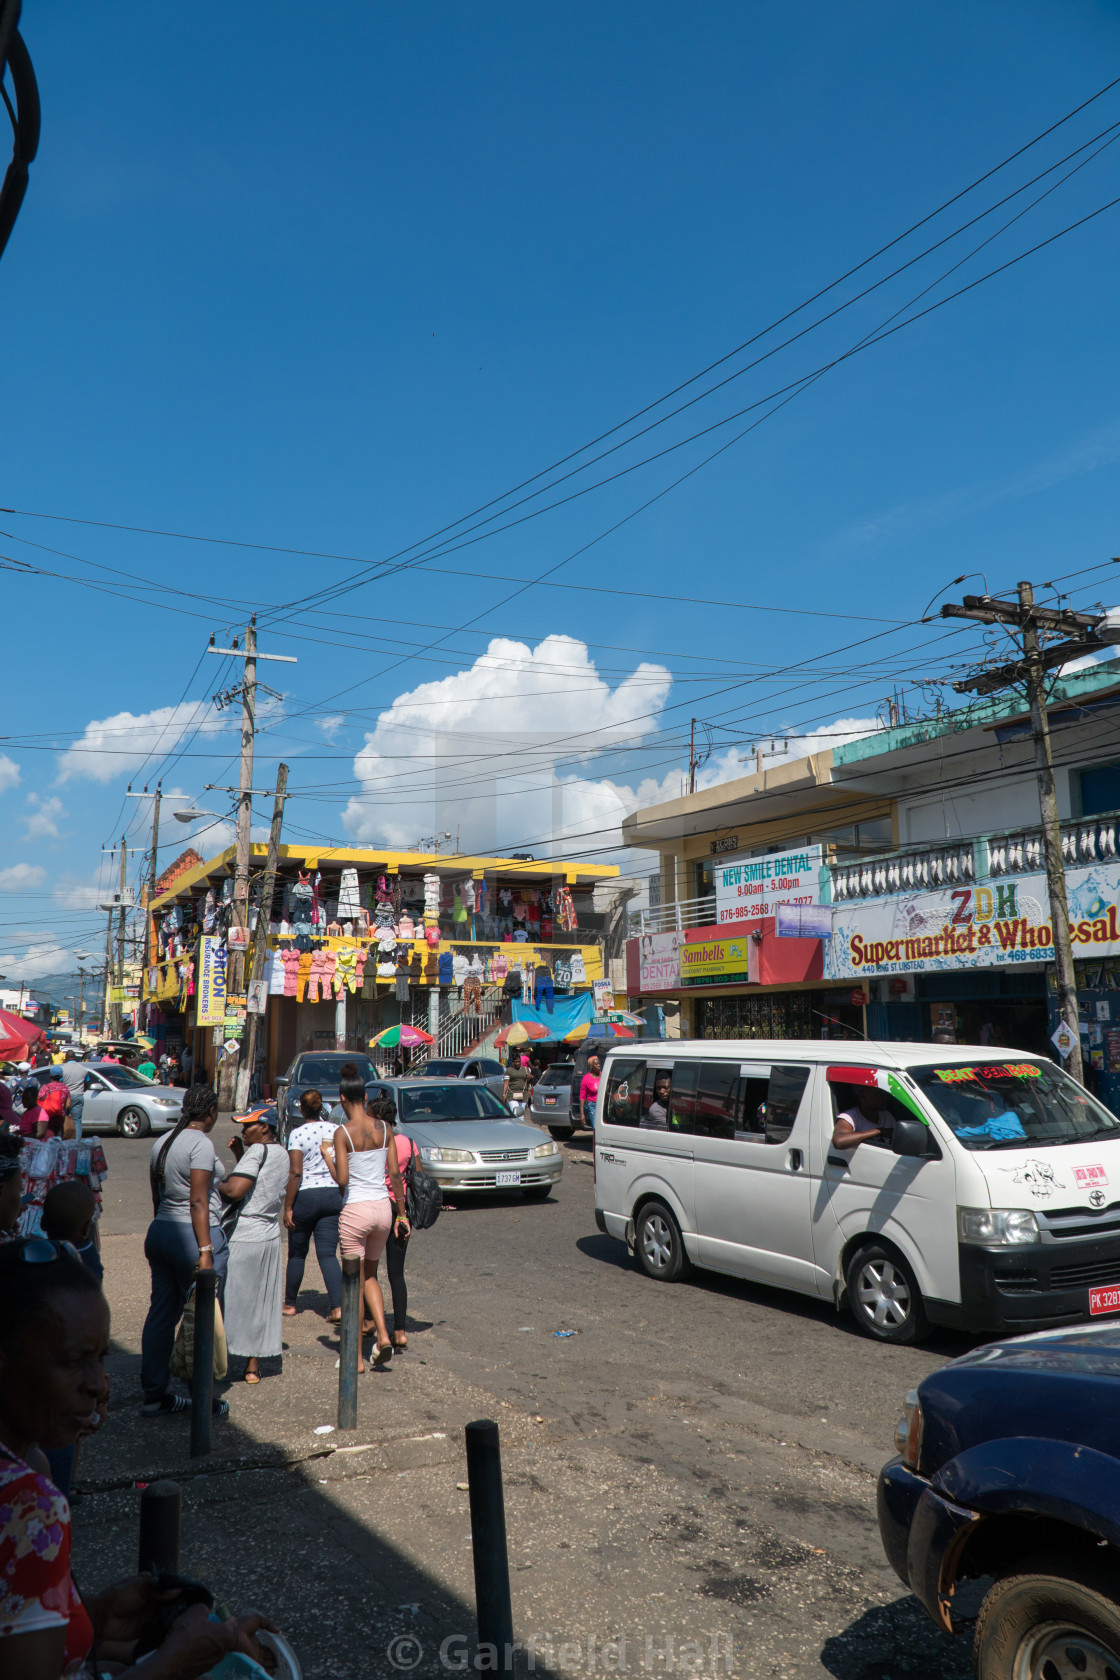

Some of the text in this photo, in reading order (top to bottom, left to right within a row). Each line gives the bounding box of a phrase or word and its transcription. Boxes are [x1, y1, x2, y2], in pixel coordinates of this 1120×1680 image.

[723, 853, 812, 887] NEW SMILE DENTAL
[737, 884, 764, 896] 9.00am
[771, 877, 800, 891] 5.00pm
[720, 903, 769, 921] 876-985-2568
[951, 884, 1017, 924] ZDH
[683, 945, 724, 964] Sambells
[1007, 948, 1055, 961] 468-6833
[202, 937, 211, 1013] INSURANCE BROKERS
[213, 948, 227, 997] ORION
[557, 970, 570, 981] 70
[933, 1067, 977, 1084] BEAT
[1003, 1064, 1042, 1077] BAD
[1091, 1294, 1101, 1308] PK
